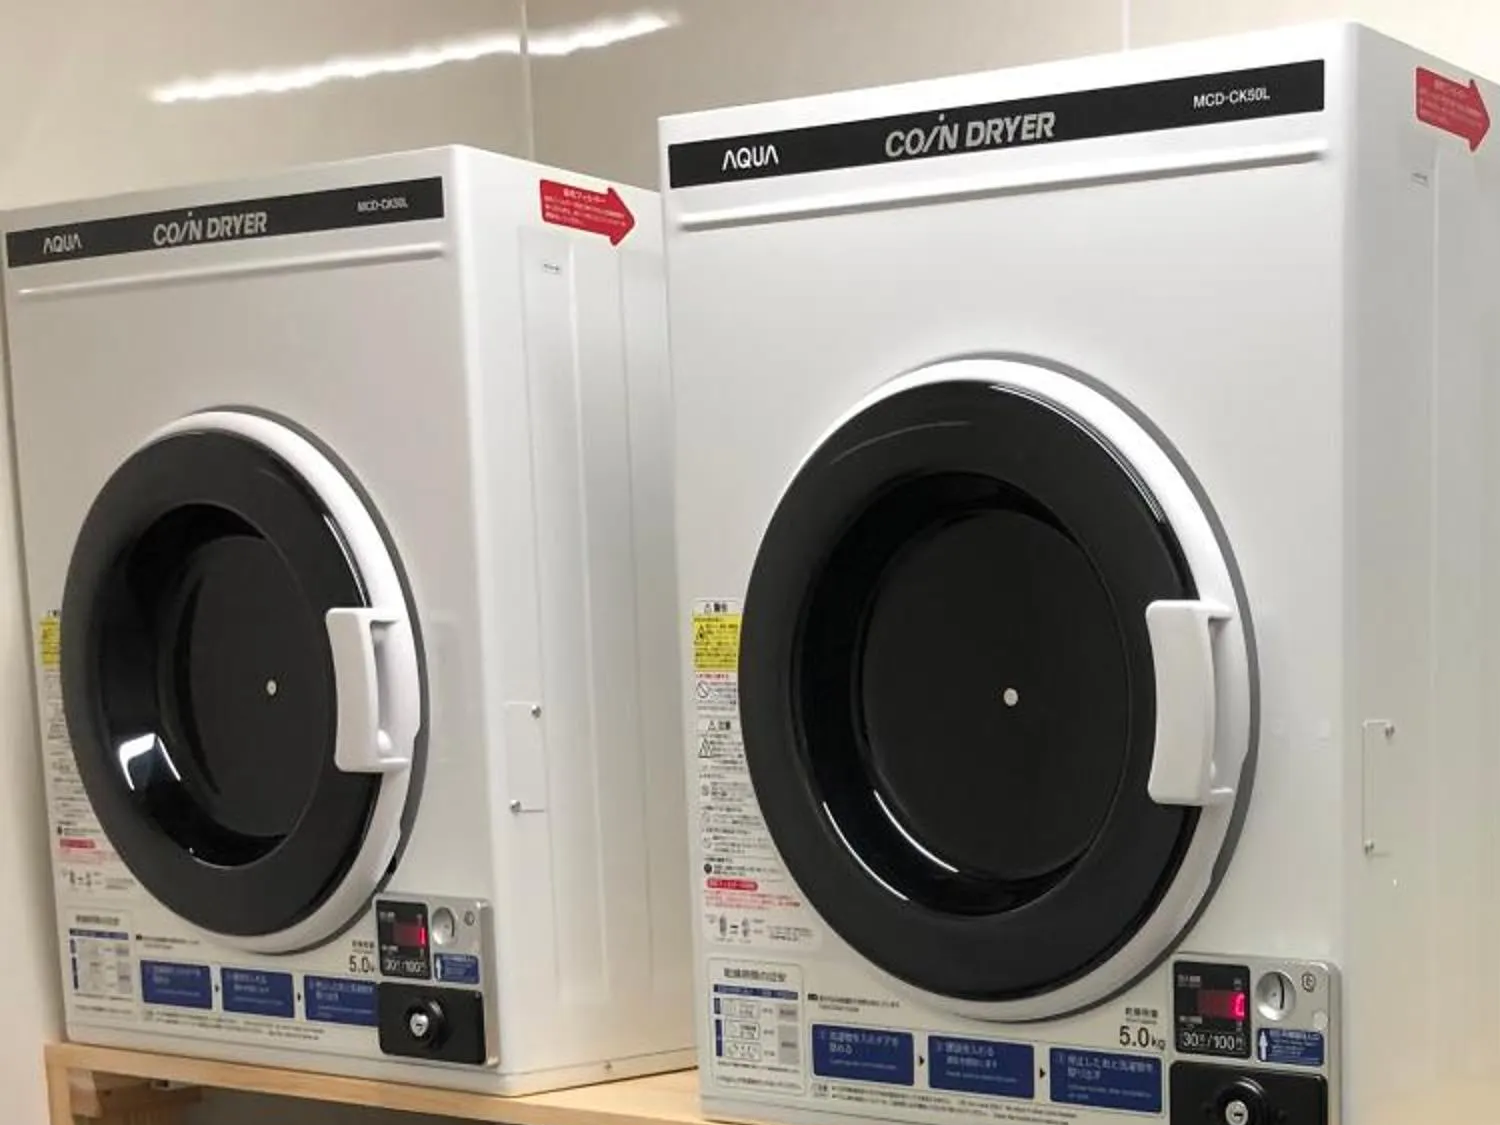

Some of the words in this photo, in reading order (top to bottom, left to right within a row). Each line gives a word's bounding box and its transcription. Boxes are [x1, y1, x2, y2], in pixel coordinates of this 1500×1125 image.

[1193, 87, 1270, 108] MCD-CK50L
[965, 112, 1056, 148] DRYER
[722, 145, 779, 171] AQUA
[206, 212, 267, 239] DRYER
[43, 232, 82, 254] AQUA
